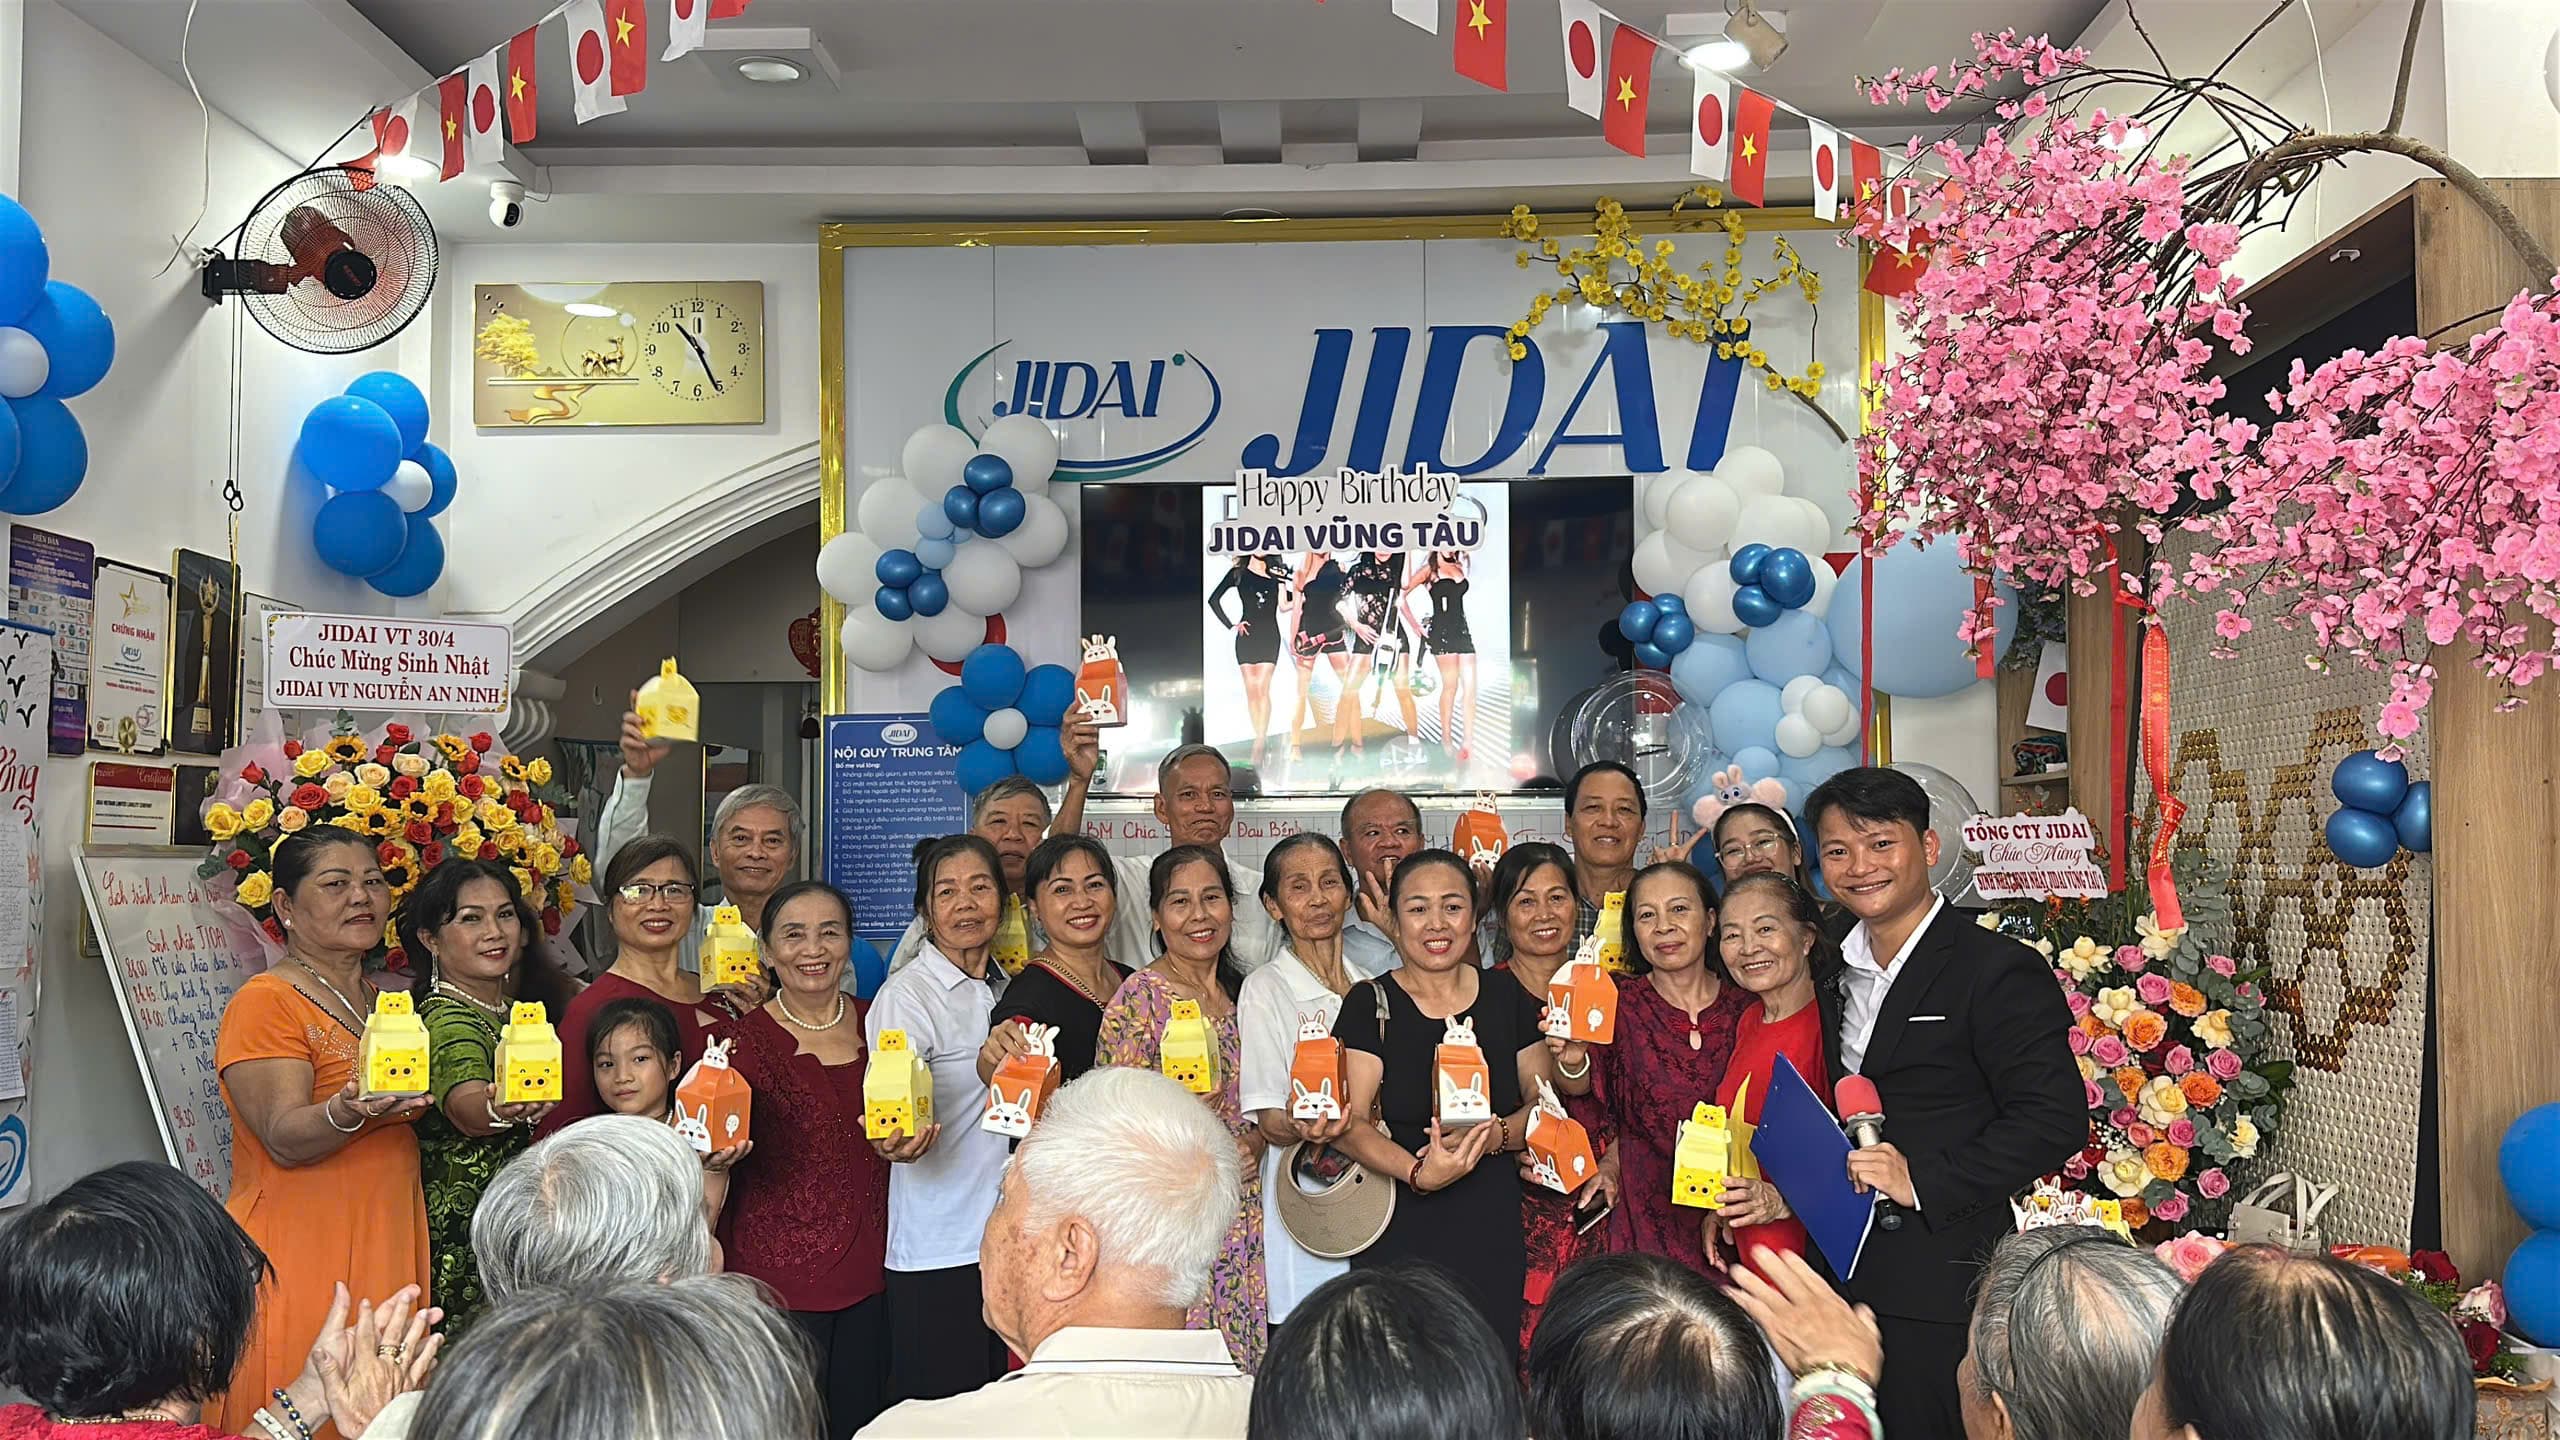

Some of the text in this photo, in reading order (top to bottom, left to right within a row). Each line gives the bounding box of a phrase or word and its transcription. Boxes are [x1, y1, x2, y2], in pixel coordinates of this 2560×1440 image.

[672, 307, 684, 319] 11
[691, 301, 704, 313] 12
[716, 307, 722, 319] 1
[656, 321, 670, 333] 10
[731, 321, 739, 333] 2
[648, 344, 656, 355] 9
[738, 343, 746, 354] 3
[655, 366, 663, 378] 8
[731, 365, 738, 376] 4
[672, 381, 680, 392] 7
[693, 384, 702, 397] 6
[715, 380, 723, 391] 5
[992, 360, 1165, 419] JIDAI
[1241, 319, 1752, 476] JIDAI
[1242, 467, 1456, 516] Happy Birthday
[1209, 513, 1480, 552] JIDAI VŨNG TÀU
[318, 624, 455, 648] JIDAI VT 30/4
[289, 646, 490, 679] Chúc Mừng Sinh Nhật
[276, 677, 500, 703] JIDAI VT NGUYỄN AN NINH
[834, 745, 857, 761] NỘI
[860, 748, 888, 759] QUY
[891, 747, 934, 758] TRUNG
[1087, 821, 1113, 839] BM
[1123, 821, 1159, 839] Chia
[1237, 821, 1264, 838] Đau
[1965, 817, 2088, 842] TỔNG CTY JIDAI
[1989, 842, 2082, 866] Chúc Mừng
